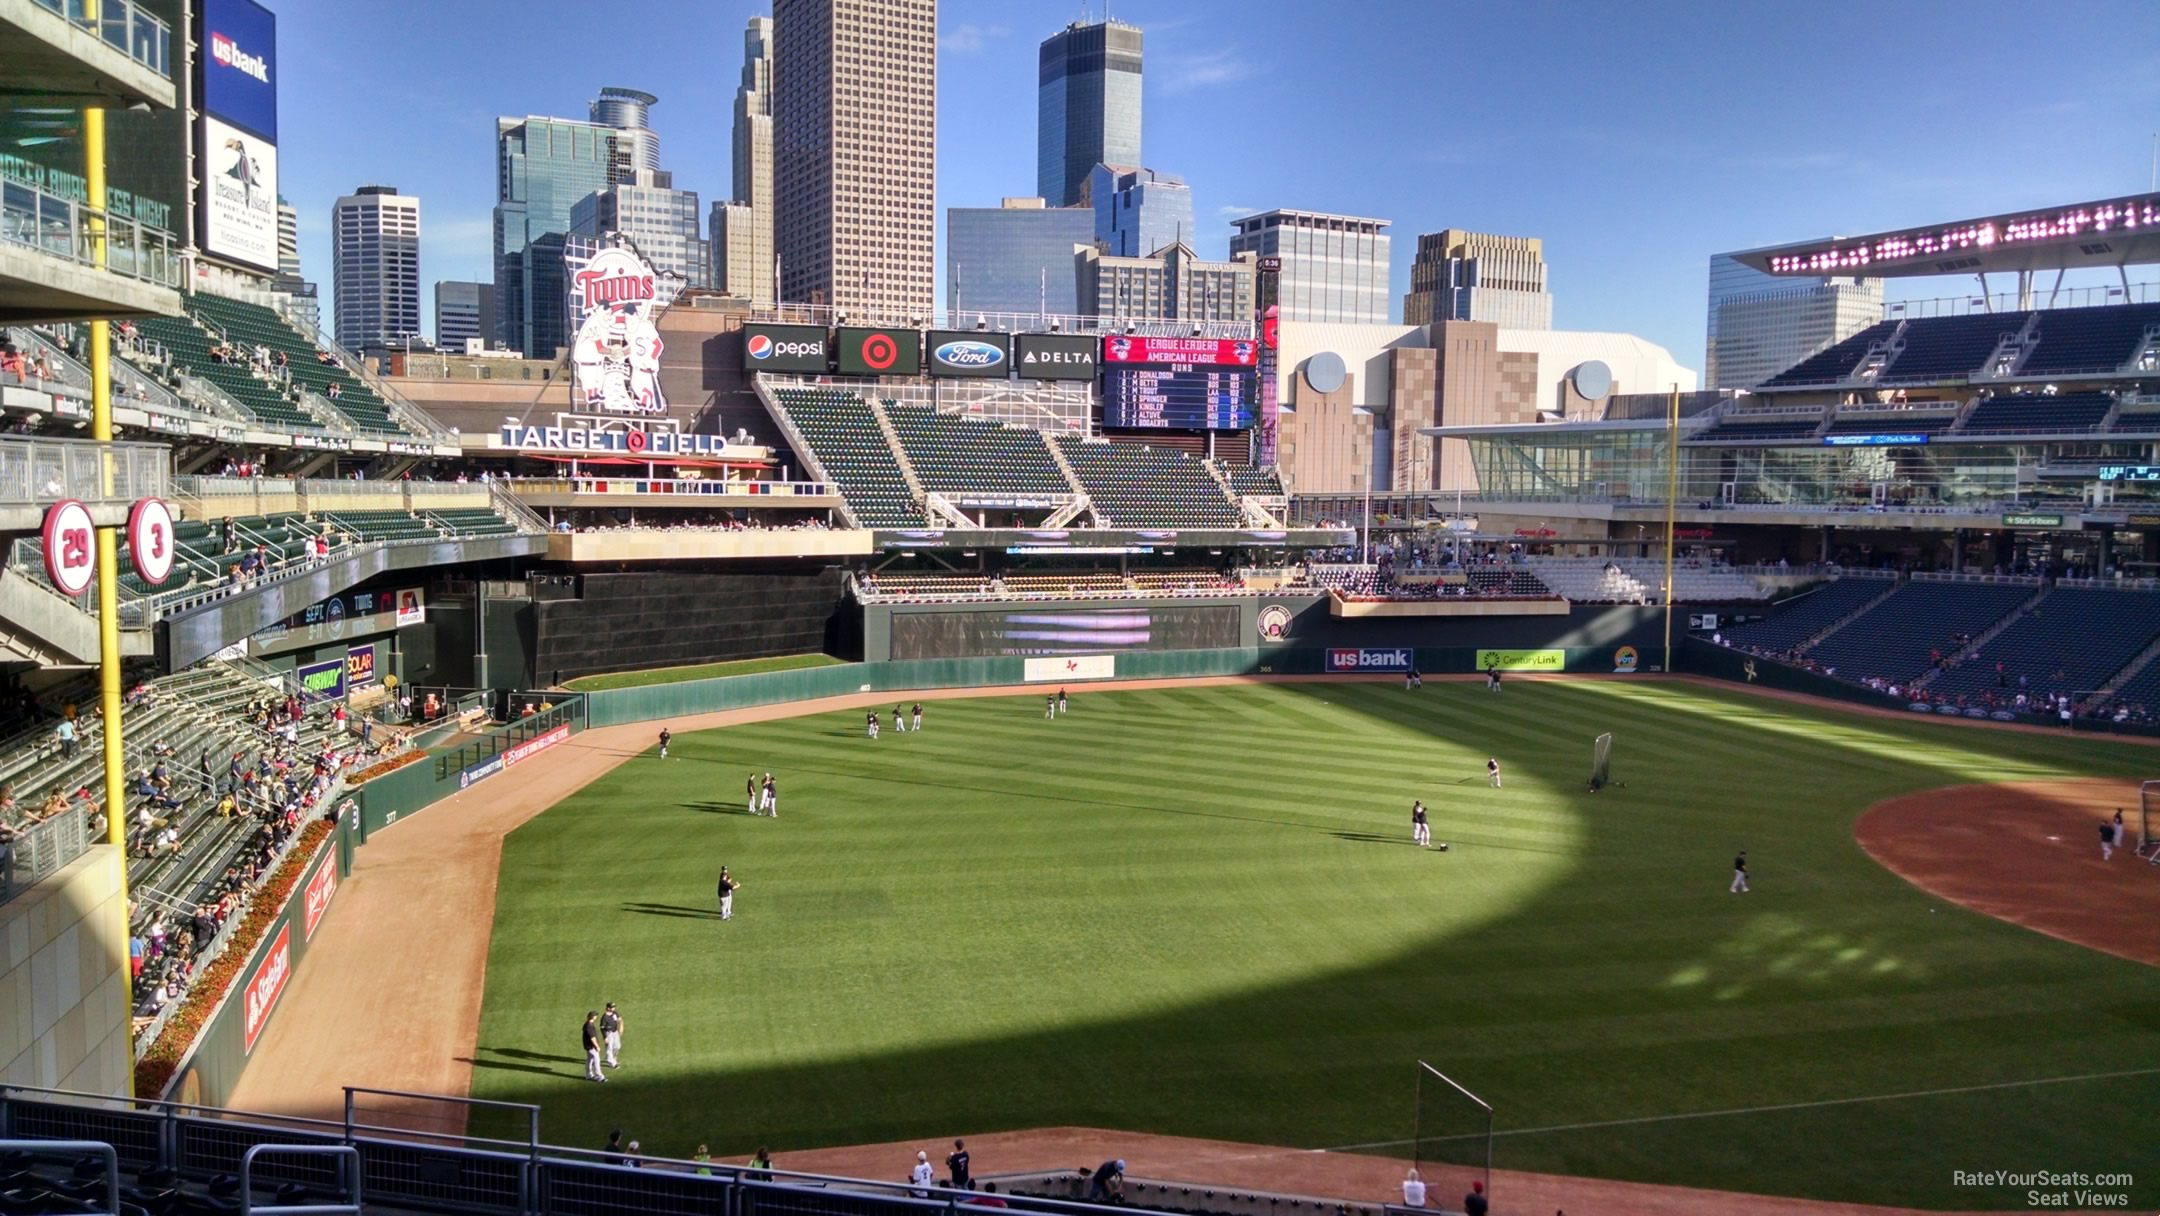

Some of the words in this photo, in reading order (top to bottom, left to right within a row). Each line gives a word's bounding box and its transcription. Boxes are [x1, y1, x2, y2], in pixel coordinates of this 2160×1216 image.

[214, 175, 244, 205] Treasure
[251, 189, 271, 215] Island
[576, 267, 654, 310] Twins
[775, 340, 824, 358] pepsi
[1146, 339, 1178, 350] LEAGUE
[1180, 340, 1219, 352] LEADERS
[948, 345, 990, 364] Ford
[1041, 351, 1092, 363] DELTA
[1147, 352, 1187, 362] AMERICAN
[1188, 354, 1216, 363] LEAGUE
[1172, 364, 1193, 372] RUNS
[1140, 371, 1174, 379] DONALDSON
[1139, 379, 1158, 387] BETTS
[1140, 387, 1158, 395] TROUT
[1139, 395, 1168, 403] SPRINGER
[1139, 411, 1161, 419] ALTUVE
[1139, 420, 1168, 428] BOGAERTS
[503, 425, 624, 450] TARGET
[652, 432, 727, 454] FIELD
[151, 523, 164, 559] 3
[63, 528, 89, 569] 29
[1503, 655, 1558, 665] CenturyLink
[304, 667, 342, 692] SUBWAY
[386, 810, 397, 824] 377
